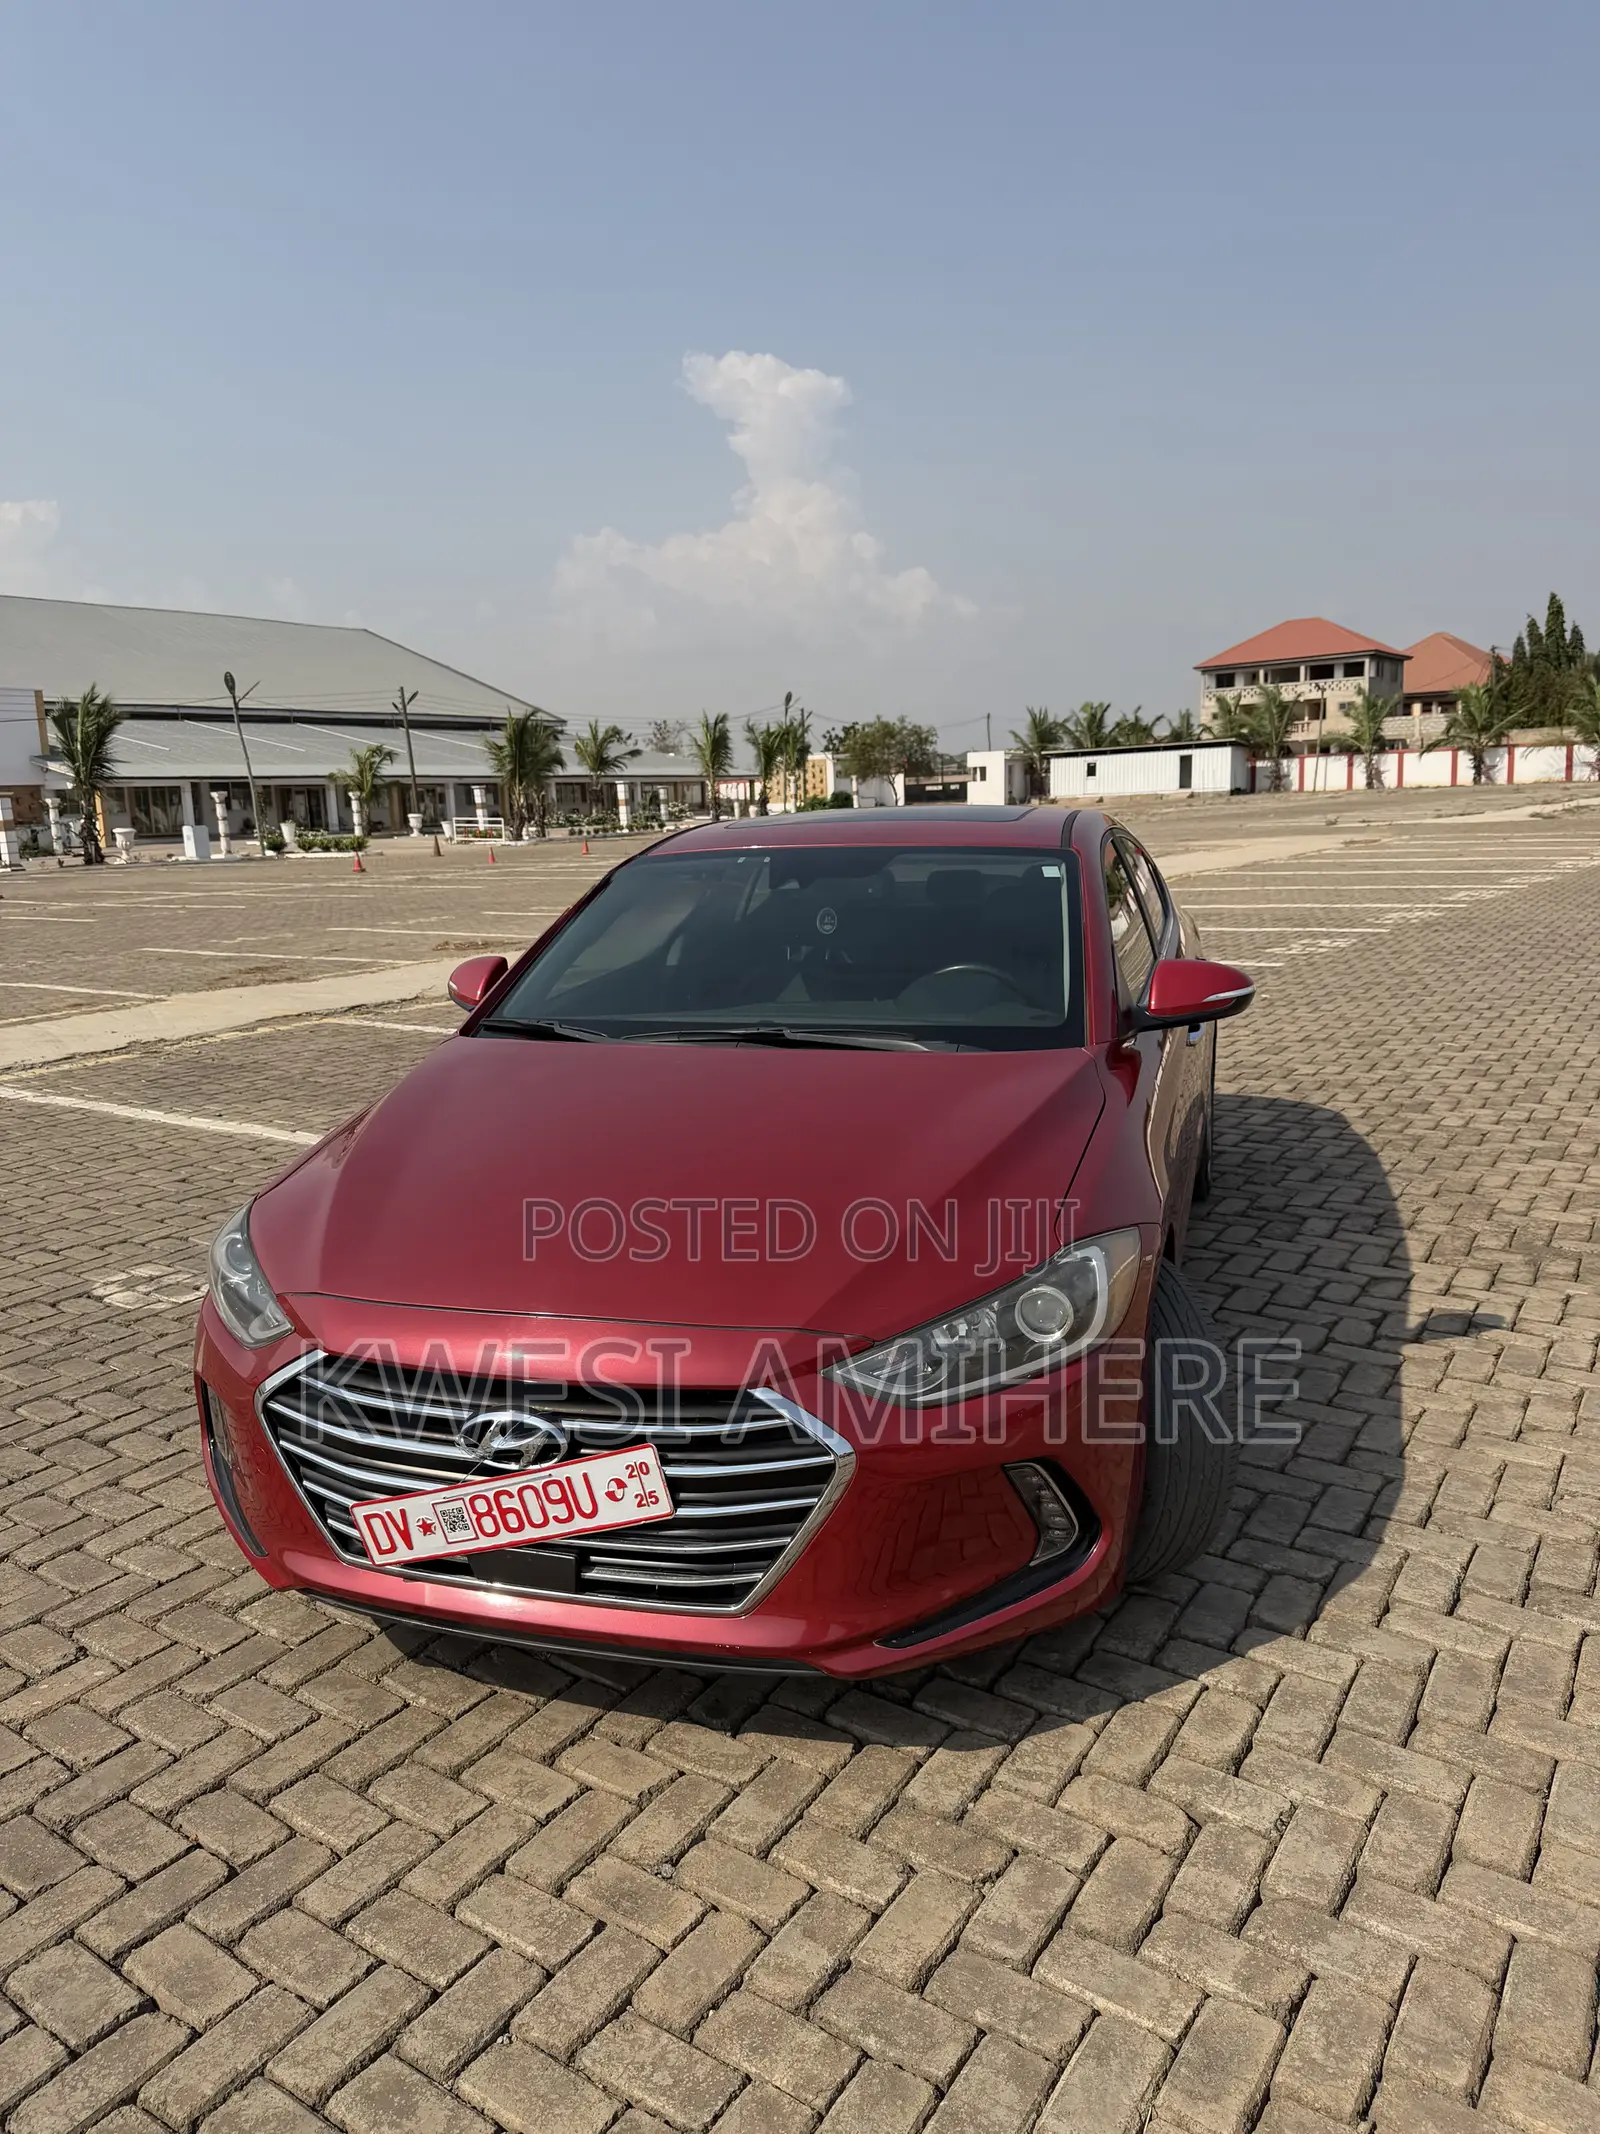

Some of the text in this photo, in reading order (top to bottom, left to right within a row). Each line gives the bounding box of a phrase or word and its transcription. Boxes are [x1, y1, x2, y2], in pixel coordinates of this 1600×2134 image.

[624, 1461, 650, 1479] 20
[634, 1489, 660, 1508] 25
[364, 1472, 599, 1556] DV 8609U
